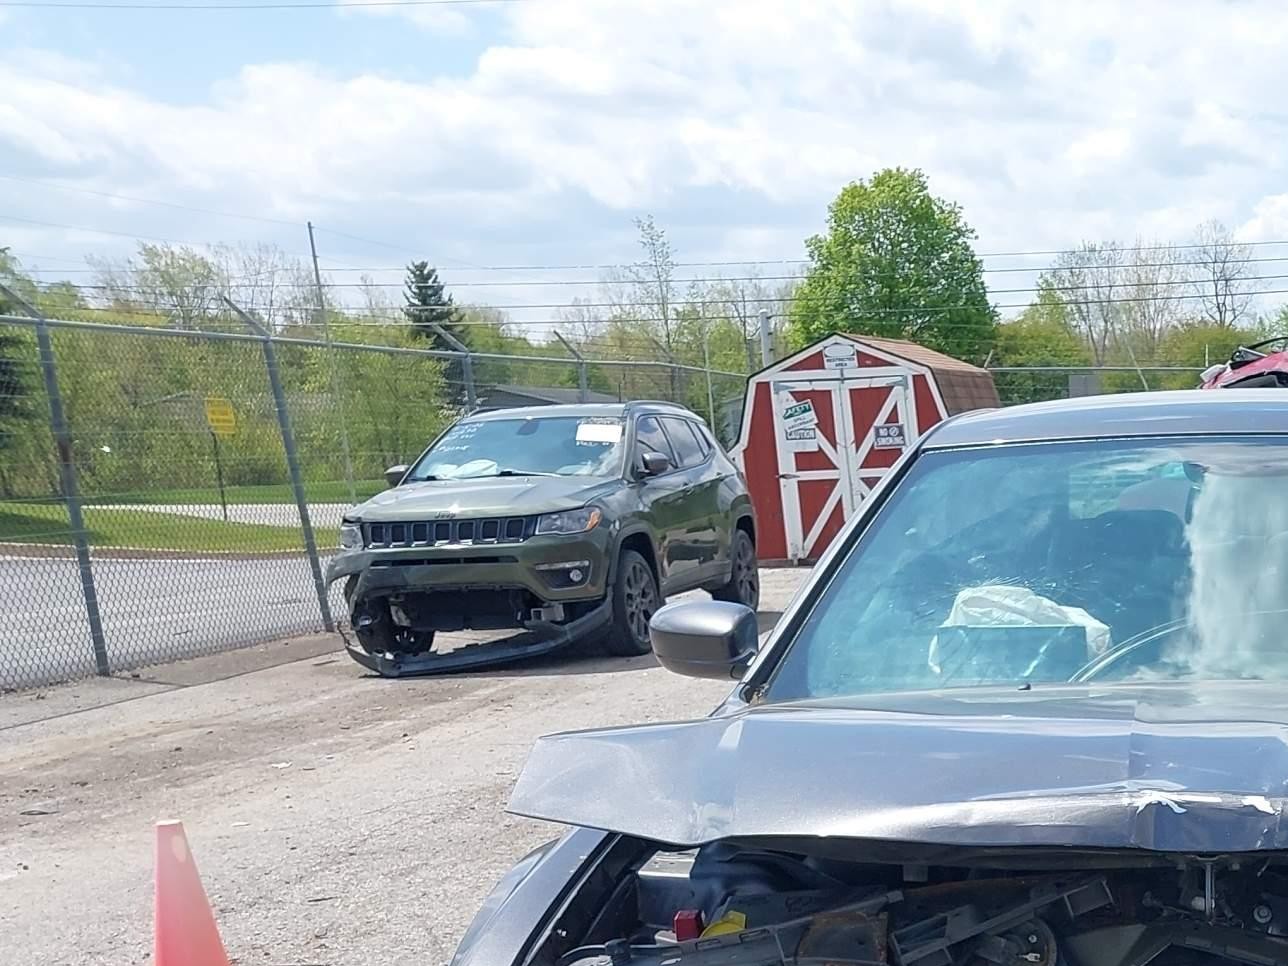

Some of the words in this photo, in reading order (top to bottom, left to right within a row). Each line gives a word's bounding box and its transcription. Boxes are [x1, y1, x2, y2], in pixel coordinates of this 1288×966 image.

[787, 430, 815, 440] CAUTION
[878, 427, 889, 436] NO
[876, 436, 905, 445] SMOKING
